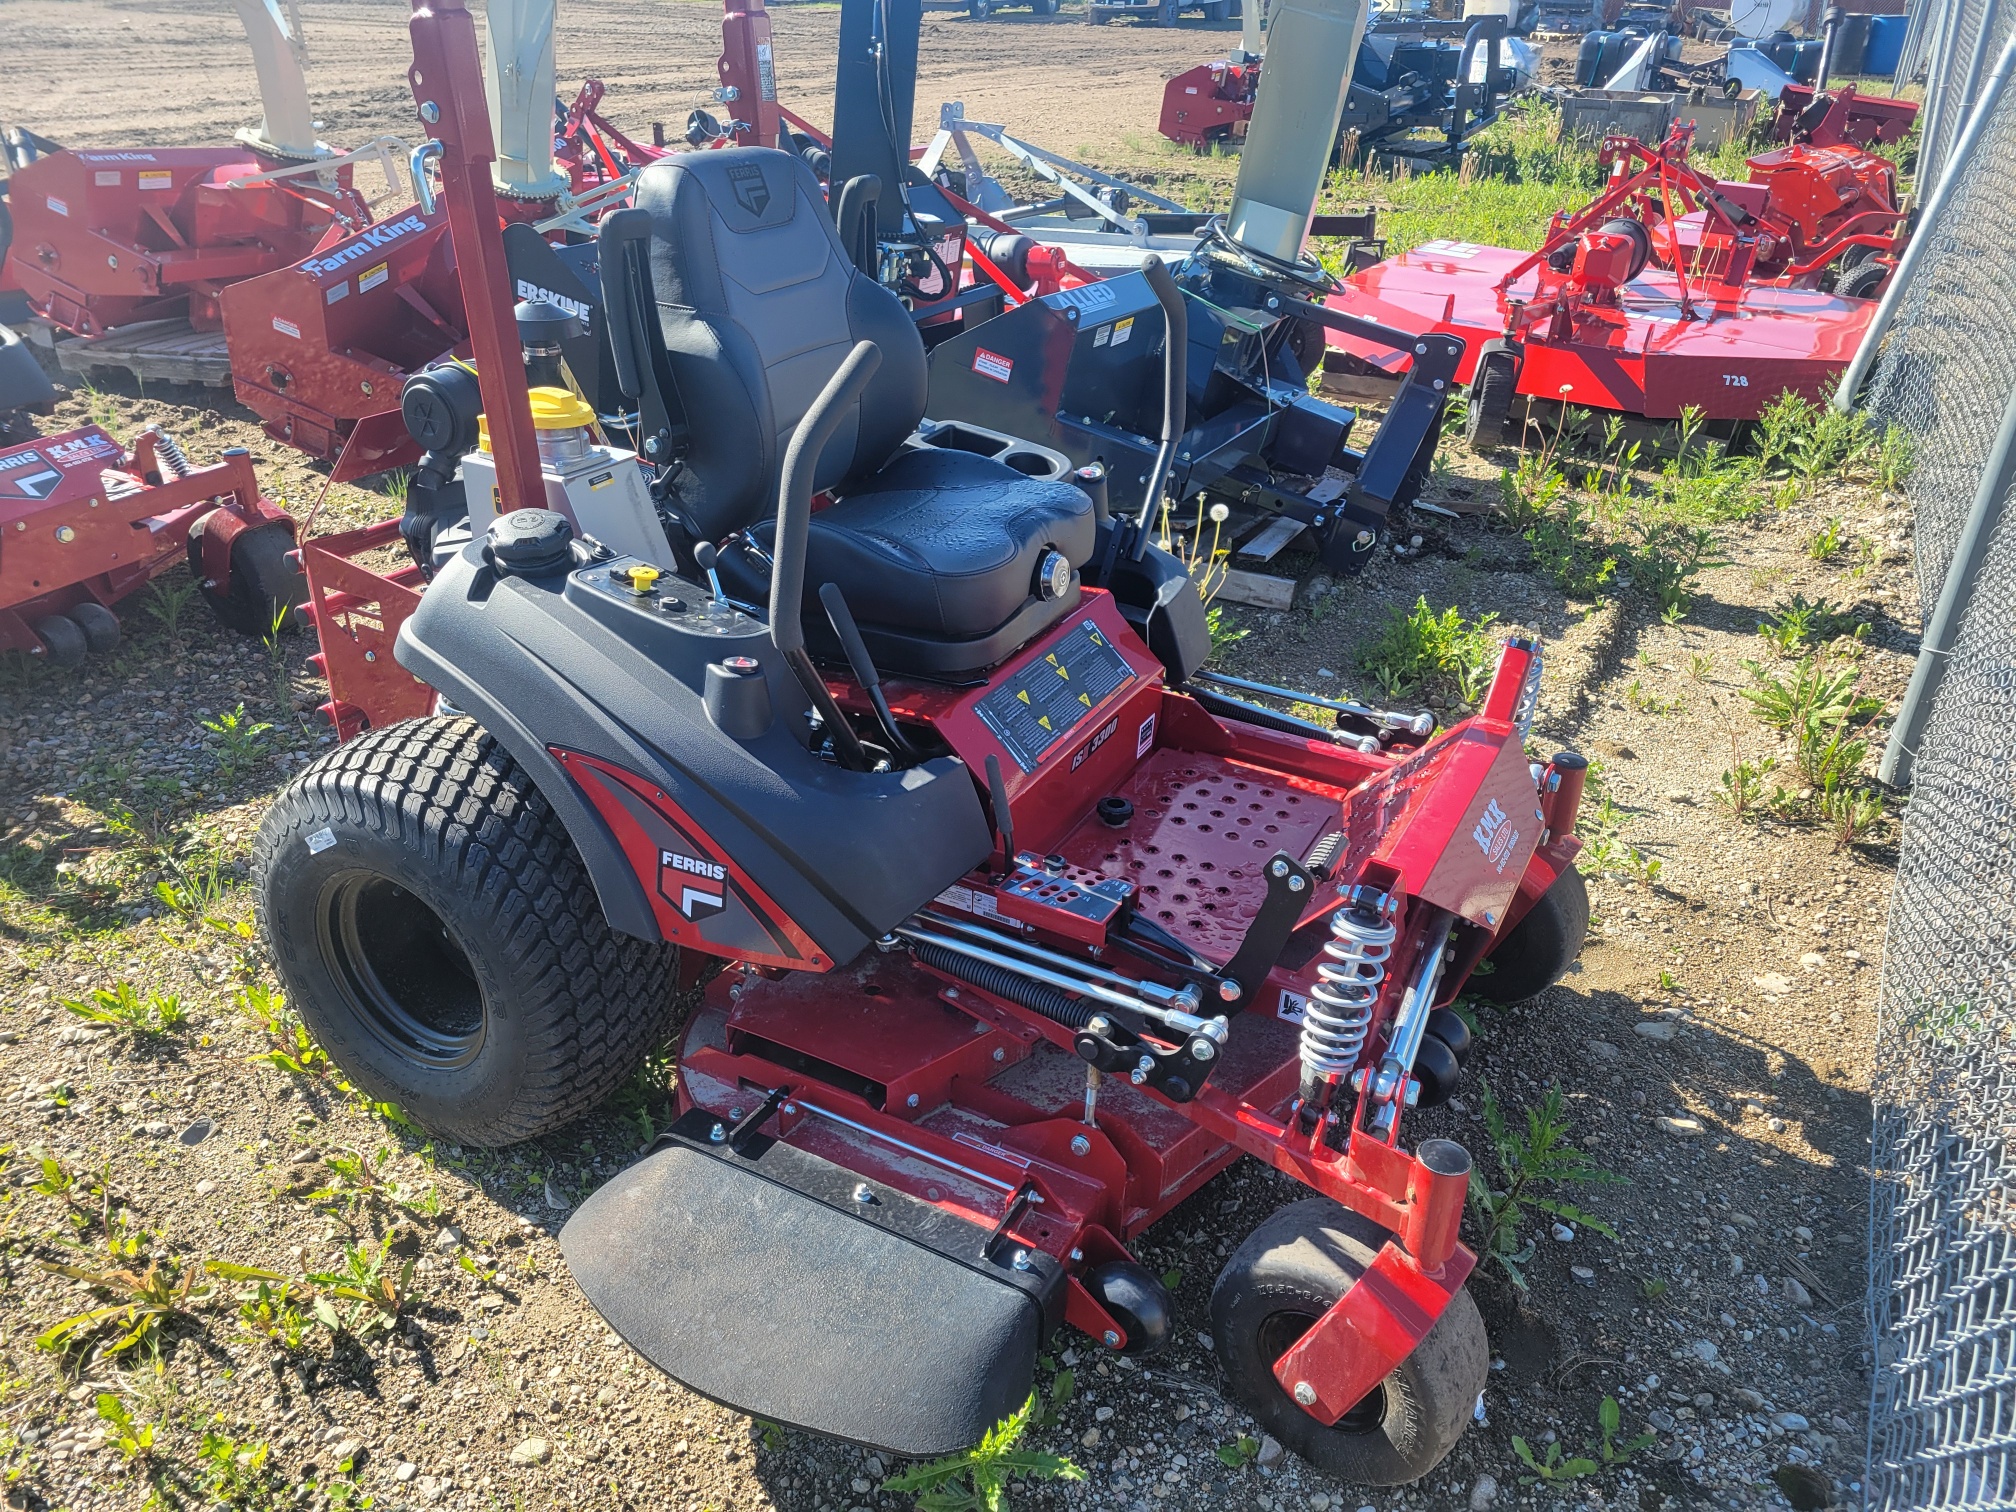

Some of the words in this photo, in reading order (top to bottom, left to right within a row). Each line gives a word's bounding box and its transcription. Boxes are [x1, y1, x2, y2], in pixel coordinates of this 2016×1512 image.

[118, 152, 157, 161] King
[729, 166, 759, 179] FERRIS
[301, 242, 373, 277] Farm
[362, 215, 427, 247] King
[517, 279, 590, 322] ERSKINE
[1056, 283, 1116, 308] ALLIED
[985, 354, 1011, 368] DANGER
[1722, 374, 1749, 387] 728
[45, 434, 108, 459] KMK
[1091, 716, 1119, 752] 3300
[1473, 798, 1507, 855] KMK
[662, 850, 725, 880] FERRIS
[981, 1145, 1006, 1157] DANGER
